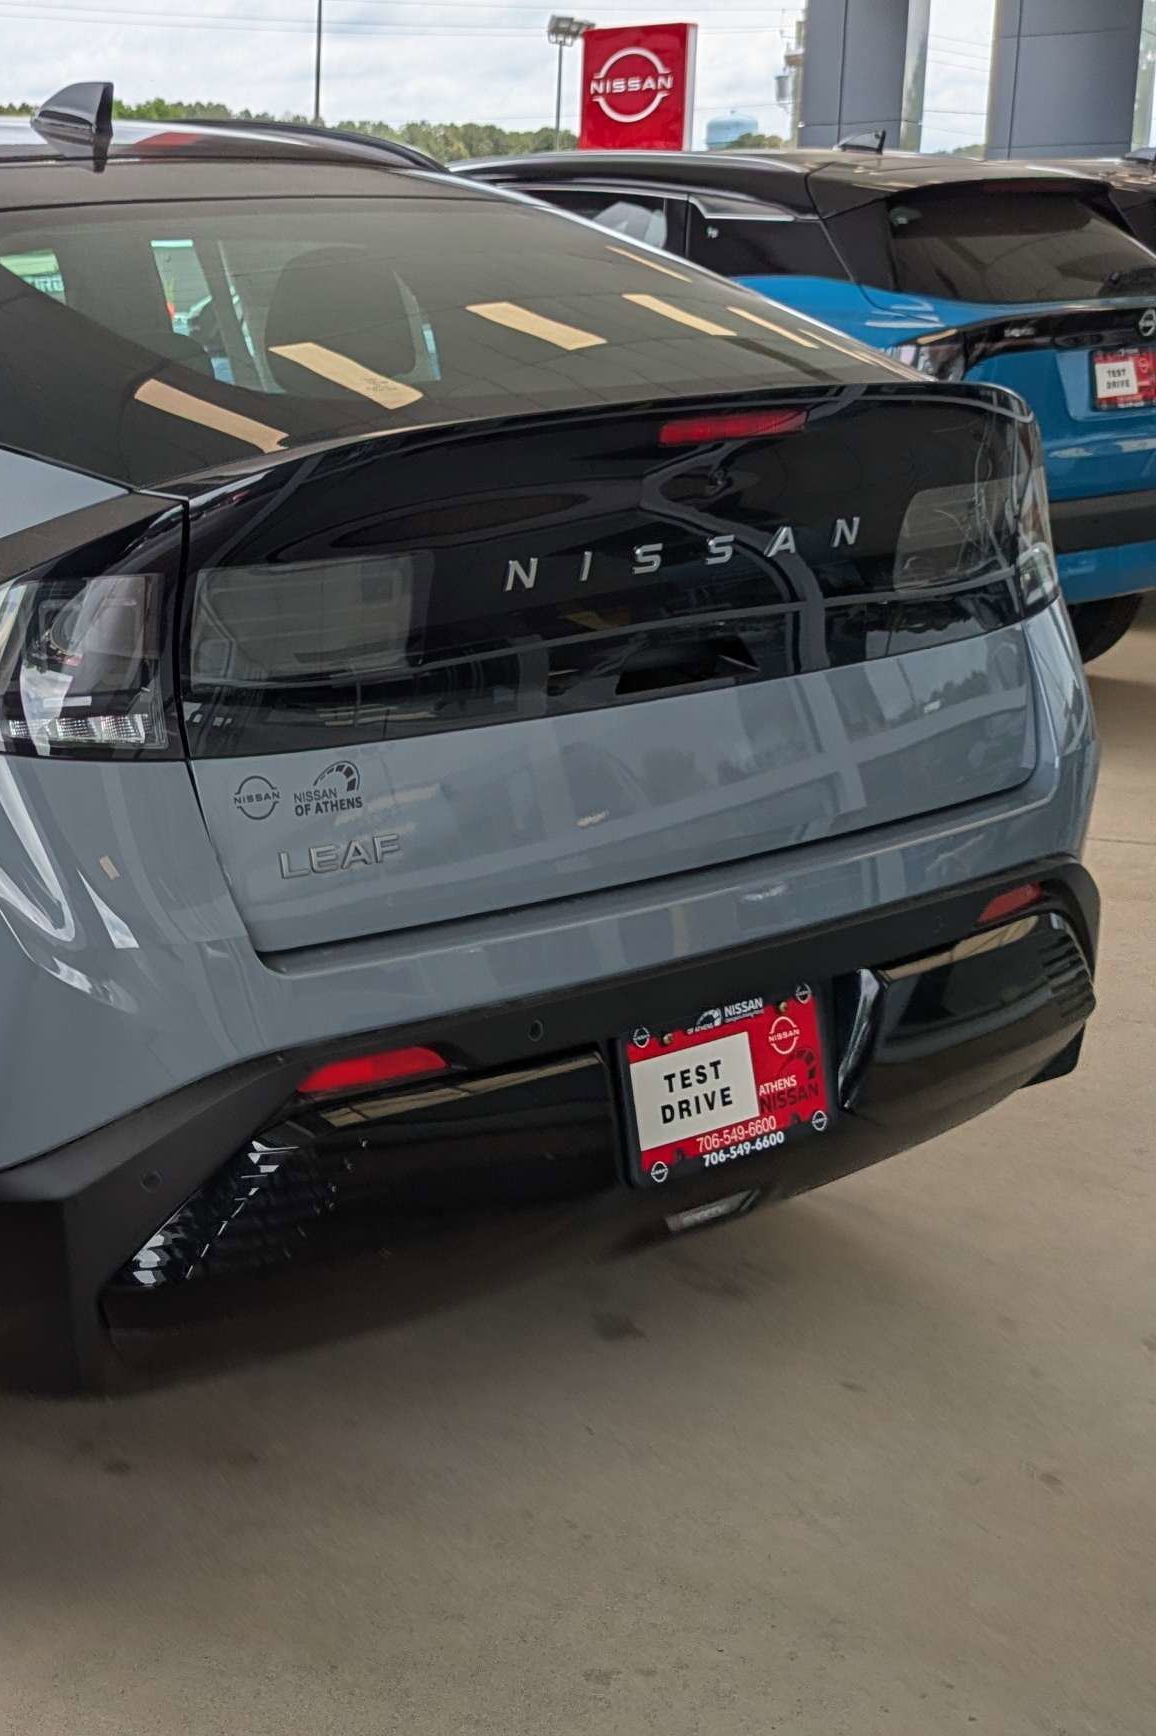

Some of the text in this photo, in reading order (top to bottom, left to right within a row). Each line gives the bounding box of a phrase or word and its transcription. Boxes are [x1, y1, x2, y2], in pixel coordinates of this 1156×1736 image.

[590, 76, 674, 95] NISSAN
[1106, 369, 1126, 378] TEST
[1106, 380, 1130, 389] DRIVE
[504, 516, 861, 592] NISSAN
[233, 791, 281, 805] NISSAN
[294, 788, 338, 803] NISSAN
[294, 796, 363, 817] OF ATHENS
[278, 833, 401, 879] LEAF
[724, 997, 764, 1018] NISSAN
[768, 1028, 800, 1042] NISSAN
[664, 1059, 723, 1093] TEST
[759, 1075, 797, 1096] ATHENS
[660, 1086, 733, 1125] DRIVE
[759, 1082, 819, 1113] NISSAN
[696, 1115, 777, 1153] 706-549-6600
[703, 1131, 785, 1168] 706-549-6600
